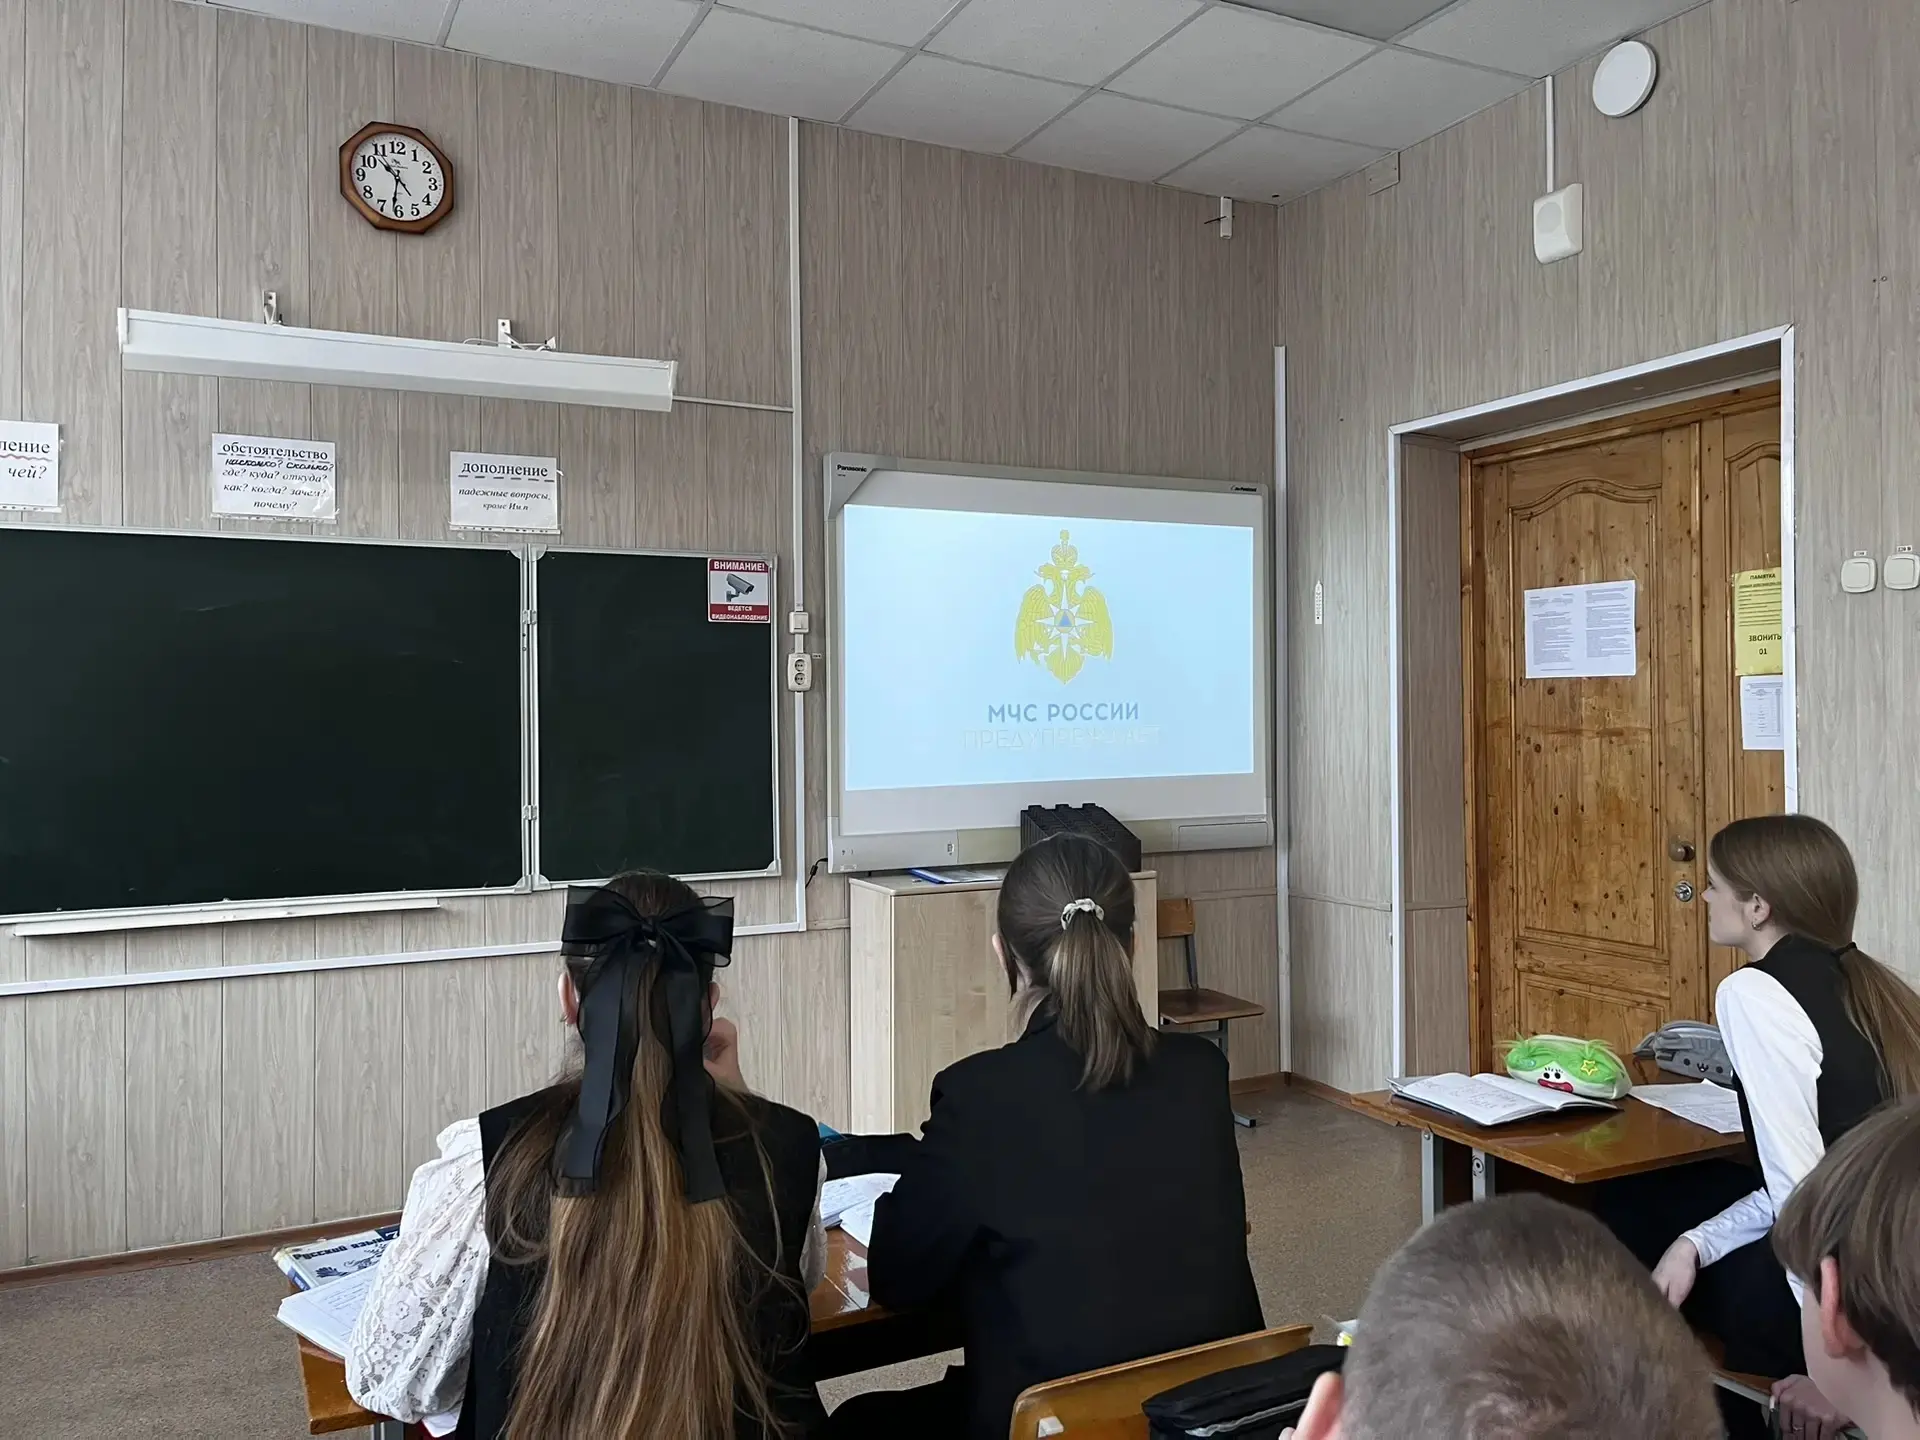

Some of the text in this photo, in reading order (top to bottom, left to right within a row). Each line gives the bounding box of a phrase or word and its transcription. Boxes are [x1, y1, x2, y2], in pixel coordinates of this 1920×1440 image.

[372, 143, 387, 157] 11
[389, 141, 406, 155] 12
[361, 155, 377, 169] 10
[411, 149, 419, 162] 1
[422, 161, 432, 174] 2
[355, 168, 366, 181] 9
[428, 178, 438, 191] 3
[363, 185, 373, 199] 8
[377, 199, 387, 212] 7
[422, 193, 432, 206] 4
[394, 205, 404, 218] 6
[411, 203, 420, 216] 5
[222, 442, 328, 460] обстоятельство
[8, 465, 47, 479] чей?
[286, 461, 334, 472] сколько?
[461, 462, 548, 477] дополнение
[836, 464, 867, 472] Panasonic
[222, 468, 327, 483] где? куда? откуда?
[223, 483, 326, 497] как? когда? зачем?
[458, 488, 508, 498] падежные
[253, 501, 298, 511] почему?
[713, 561, 765, 571] ВНИМАНИЕ!
[711, 613, 768, 621] ВИДЕОНАБЛЮДЕНИЕ
[1749, 634, 1782, 642] ЗВОНИТЬ
[988, 702, 1139, 723] МЧС РОССИИ
[292, 1237, 385, 1260] Русский язык
